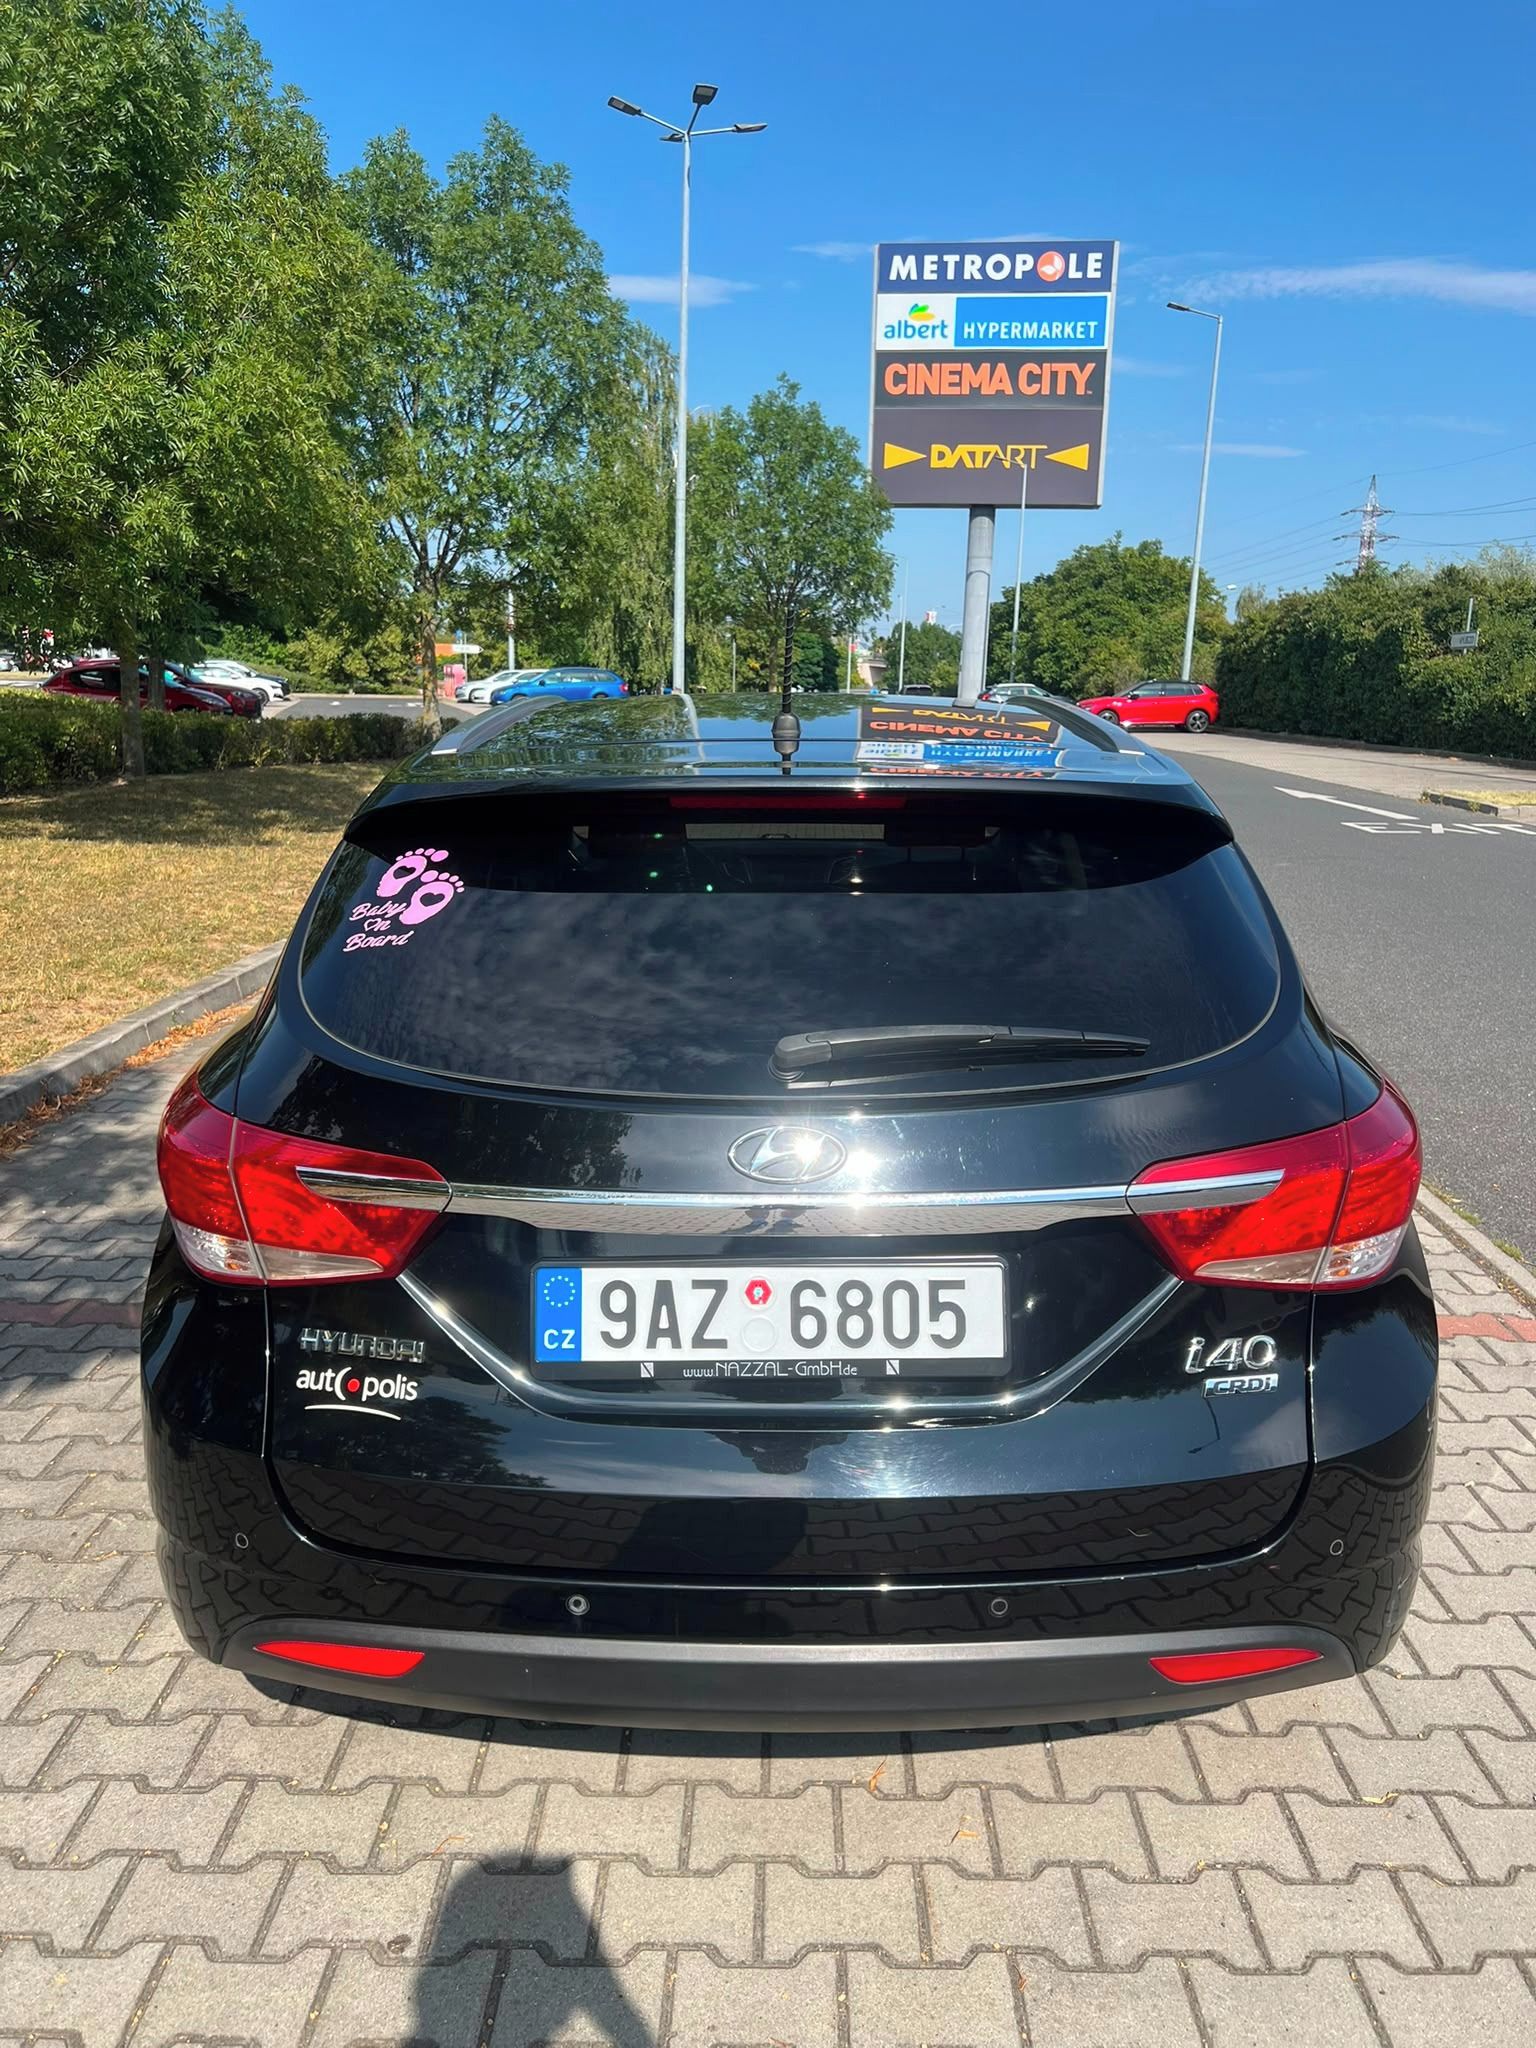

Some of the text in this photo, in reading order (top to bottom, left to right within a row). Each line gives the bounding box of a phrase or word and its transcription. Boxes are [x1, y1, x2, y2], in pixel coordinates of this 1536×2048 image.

[888, 251, 1103, 282] METROPOLE
[884, 320, 948, 339] albert
[963, 321, 1099, 339] HYPERMARKET
[884, 362, 1096, 395] CINEMA CITY
[930, 444, 1048, 469] DATART
[349, 900, 407, 921] Baby
[343, 931, 415, 952] Board
[600, 1279, 967, 1350] 9AZ 6805
[300, 1327, 425, 1363] HYUNDAI
[543, 1329, 576, 1350] CZ
[1185, 1334, 1277, 1374] i40
[683, 1360, 858, 1377] www.NAZZAL-GmbH.de
[1212, 1376, 1276, 1395] CRDi
